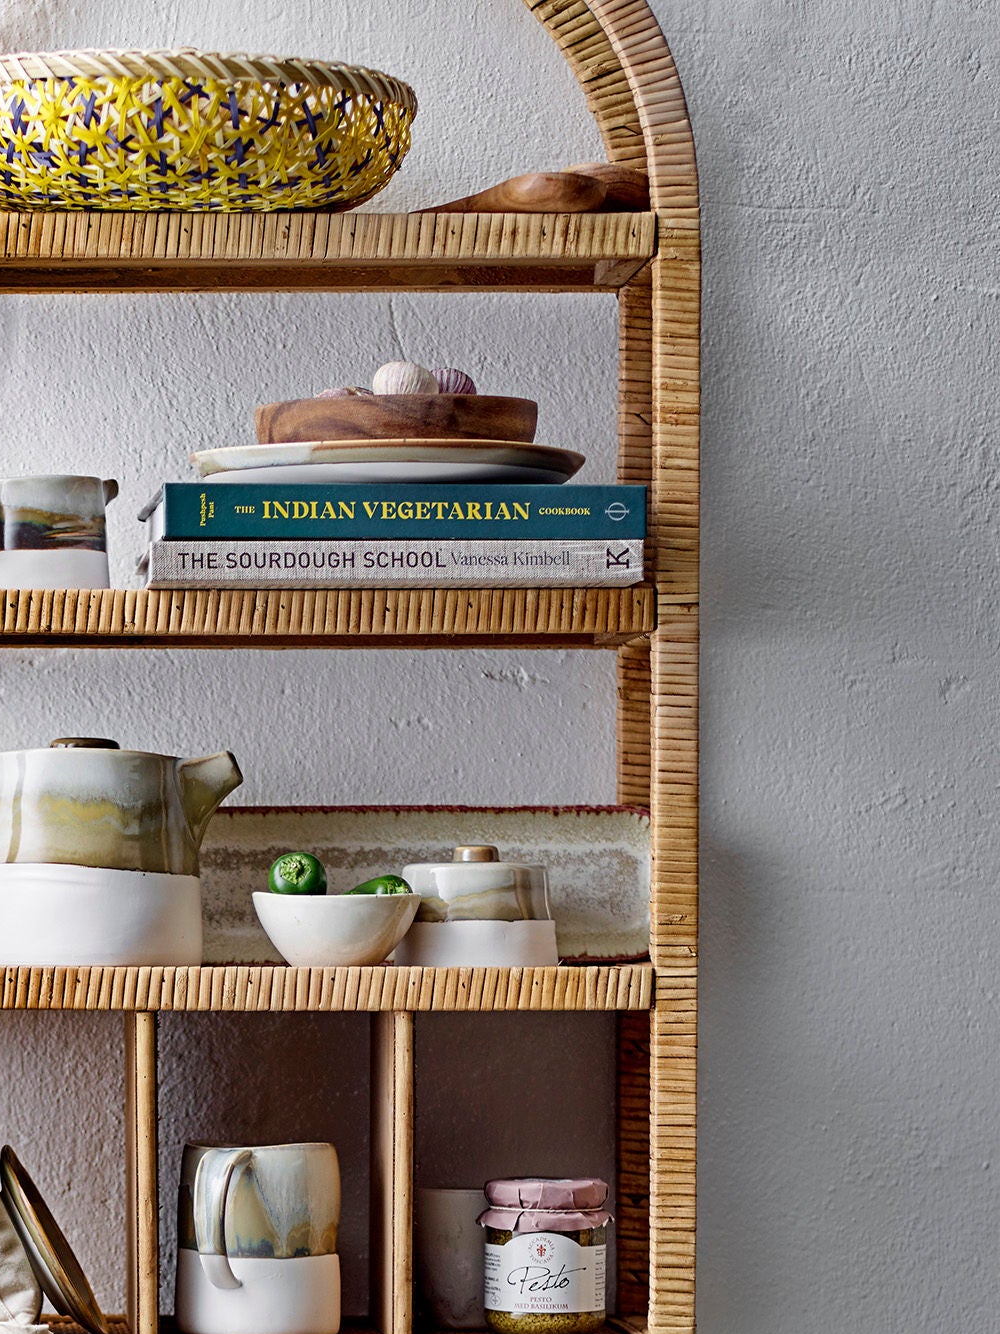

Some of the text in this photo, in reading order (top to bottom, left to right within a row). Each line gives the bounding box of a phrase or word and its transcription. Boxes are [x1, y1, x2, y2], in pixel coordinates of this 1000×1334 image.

[199, 492, 207, 527] Pushpesh
[234, 501, 591, 520] THE INDIAN VEGETARIAN COOKBOOK
[178, 551, 570, 570] THE SOURDOUGH SCHOOL Vanessa Kimbell
[605, 547, 630, 569] K
[507, 1264, 587, 1294] Pesto
